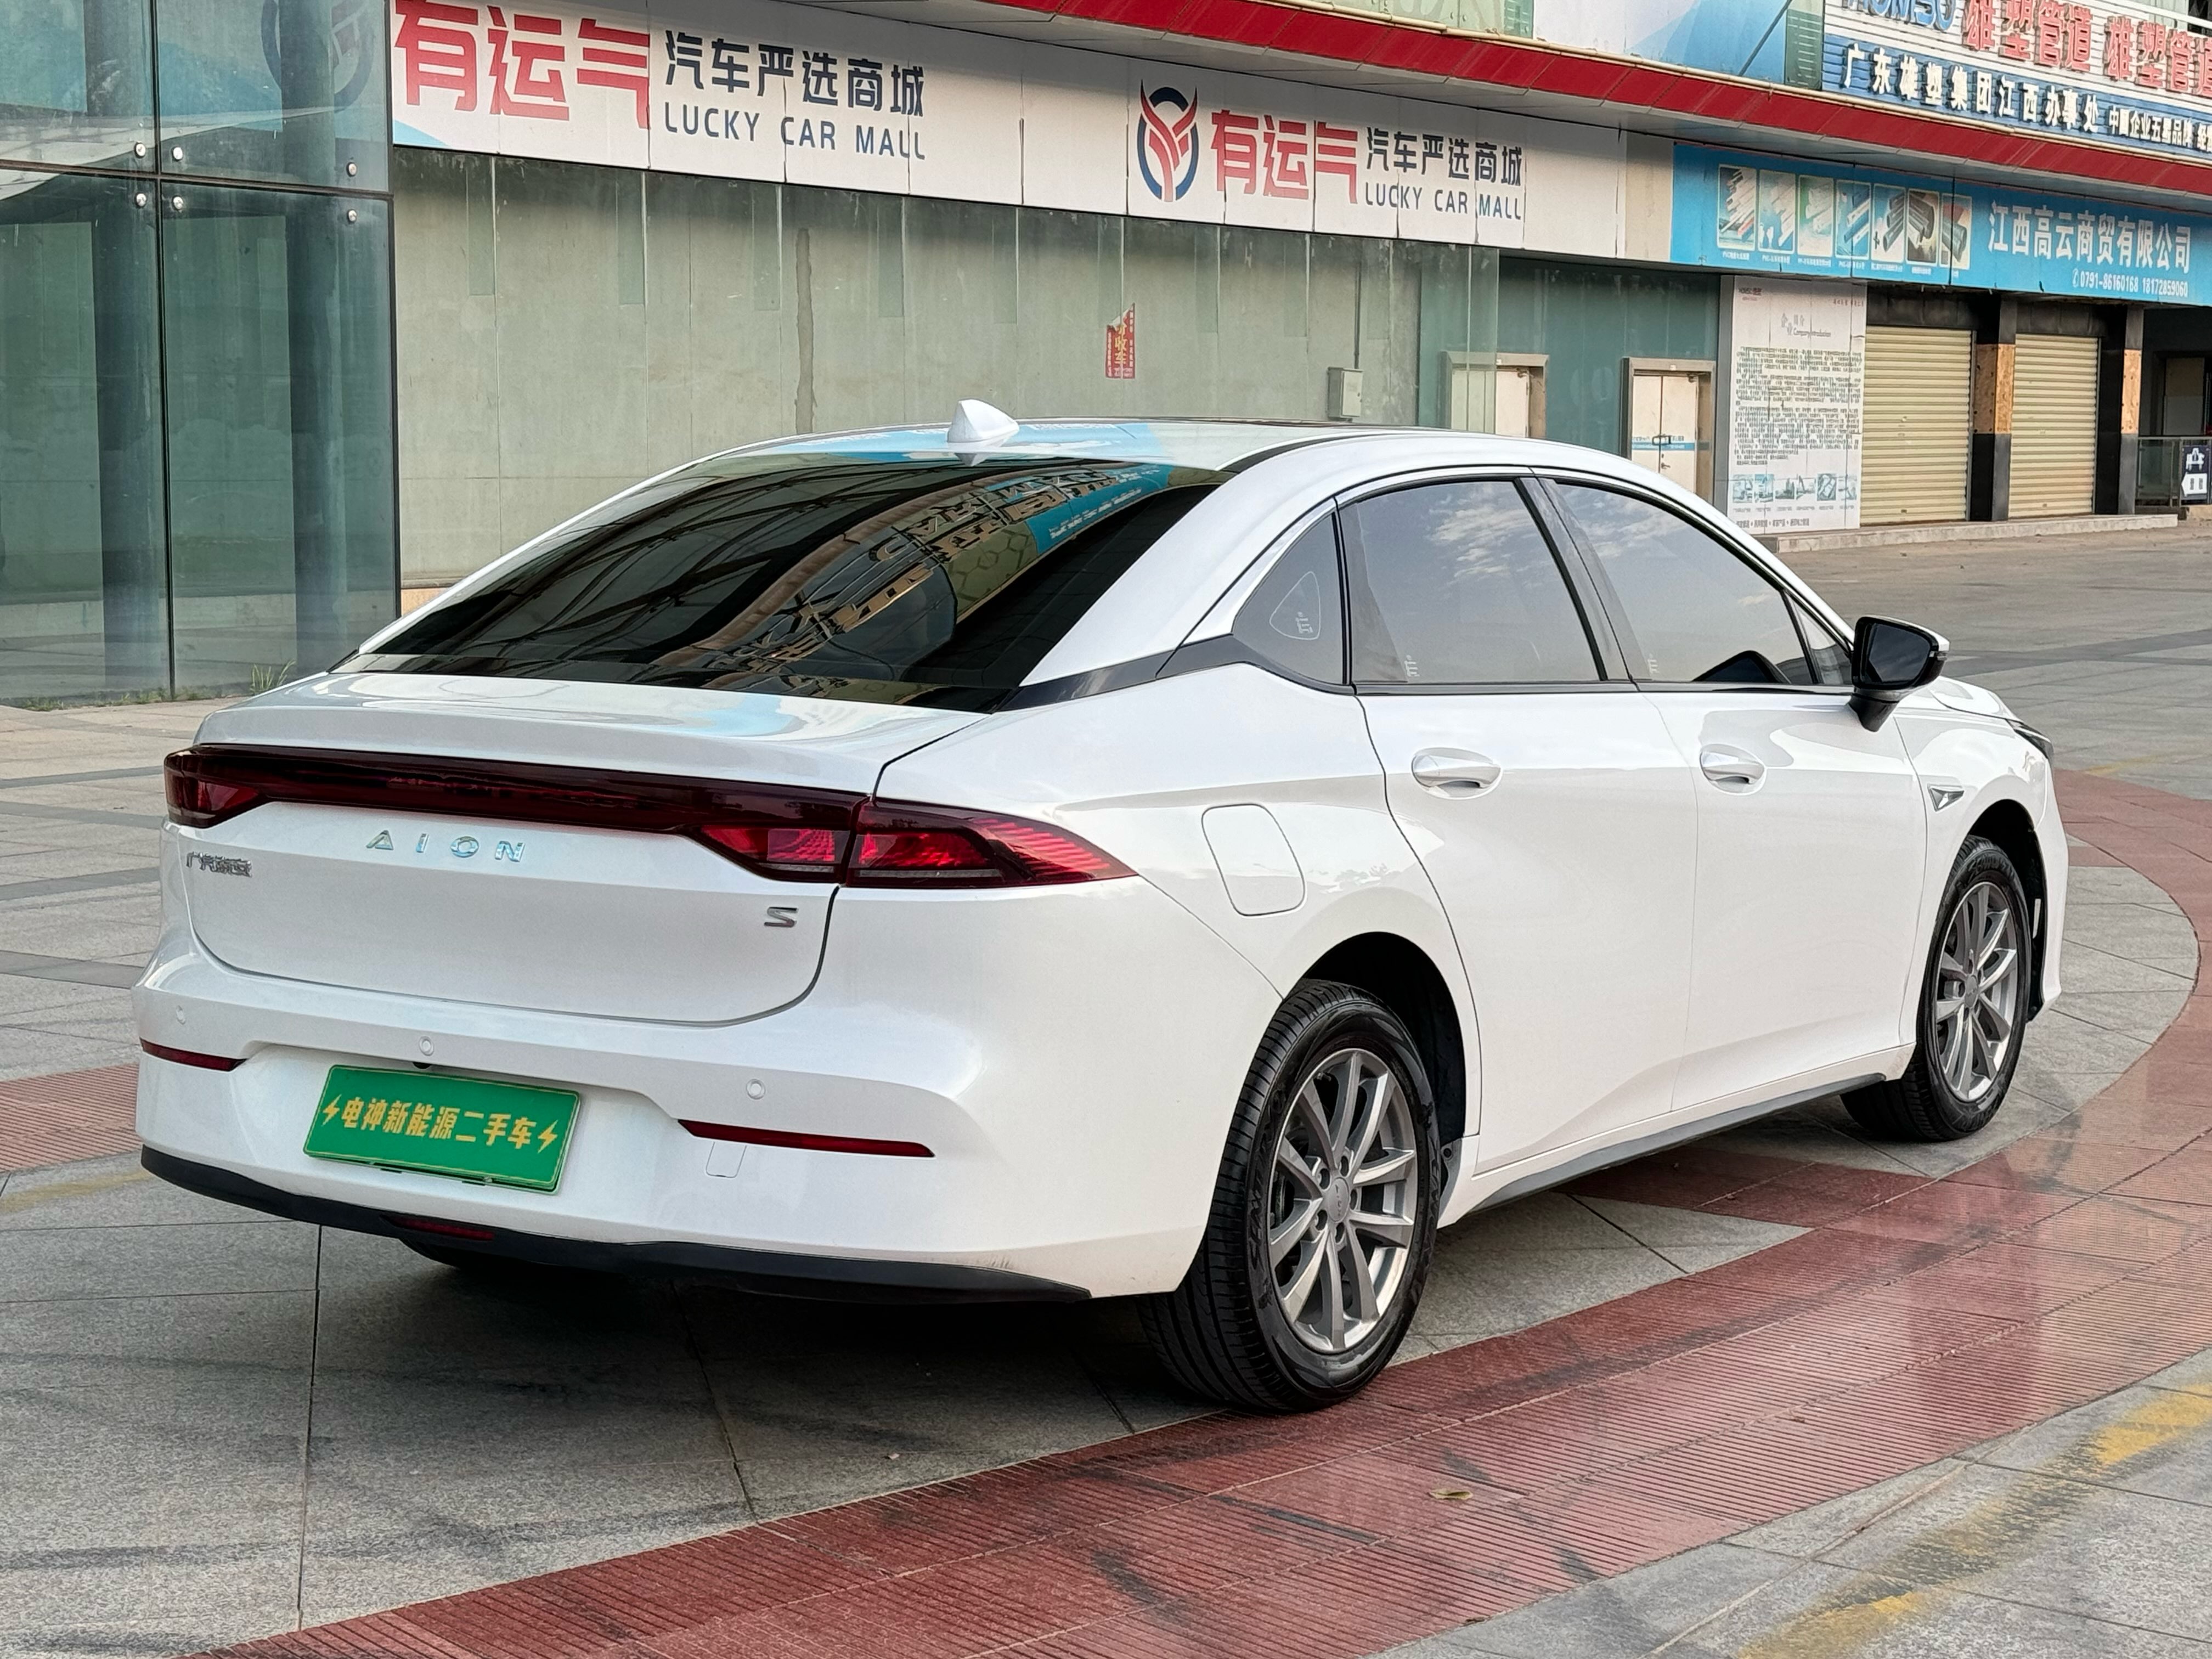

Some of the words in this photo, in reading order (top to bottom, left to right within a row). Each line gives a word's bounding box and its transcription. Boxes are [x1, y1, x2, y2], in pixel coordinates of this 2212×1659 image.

[394, 0, 651, 130] 有运气
[665, 30, 924, 117] 汽车严选商城
[1844, 43, 2100, 133] 广东雄塑集团江西办事处
[664, 101, 760, 142] LUCKY
[781, 116, 836, 150] CAR
[856, 125, 926, 160] MALL
[1210, 109, 1358, 204] 有运气
[1366, 127, 1522, 187] 汽车严选商城
[1365, 182, 1423, 210] LUCKY
[1434, 189, 1468, 214] CAR
[1479, 193, 1521, 220] MALL
[1988, 200, 2191, 274] 江西高云商贸有限公司
[2080, 270, 2139, 293] 0791-86160168
[365, 830, 526, 862] AION
[763, 906, 799, 929] S
[341, 1097, 537, 1150] 电神新能源二手车
